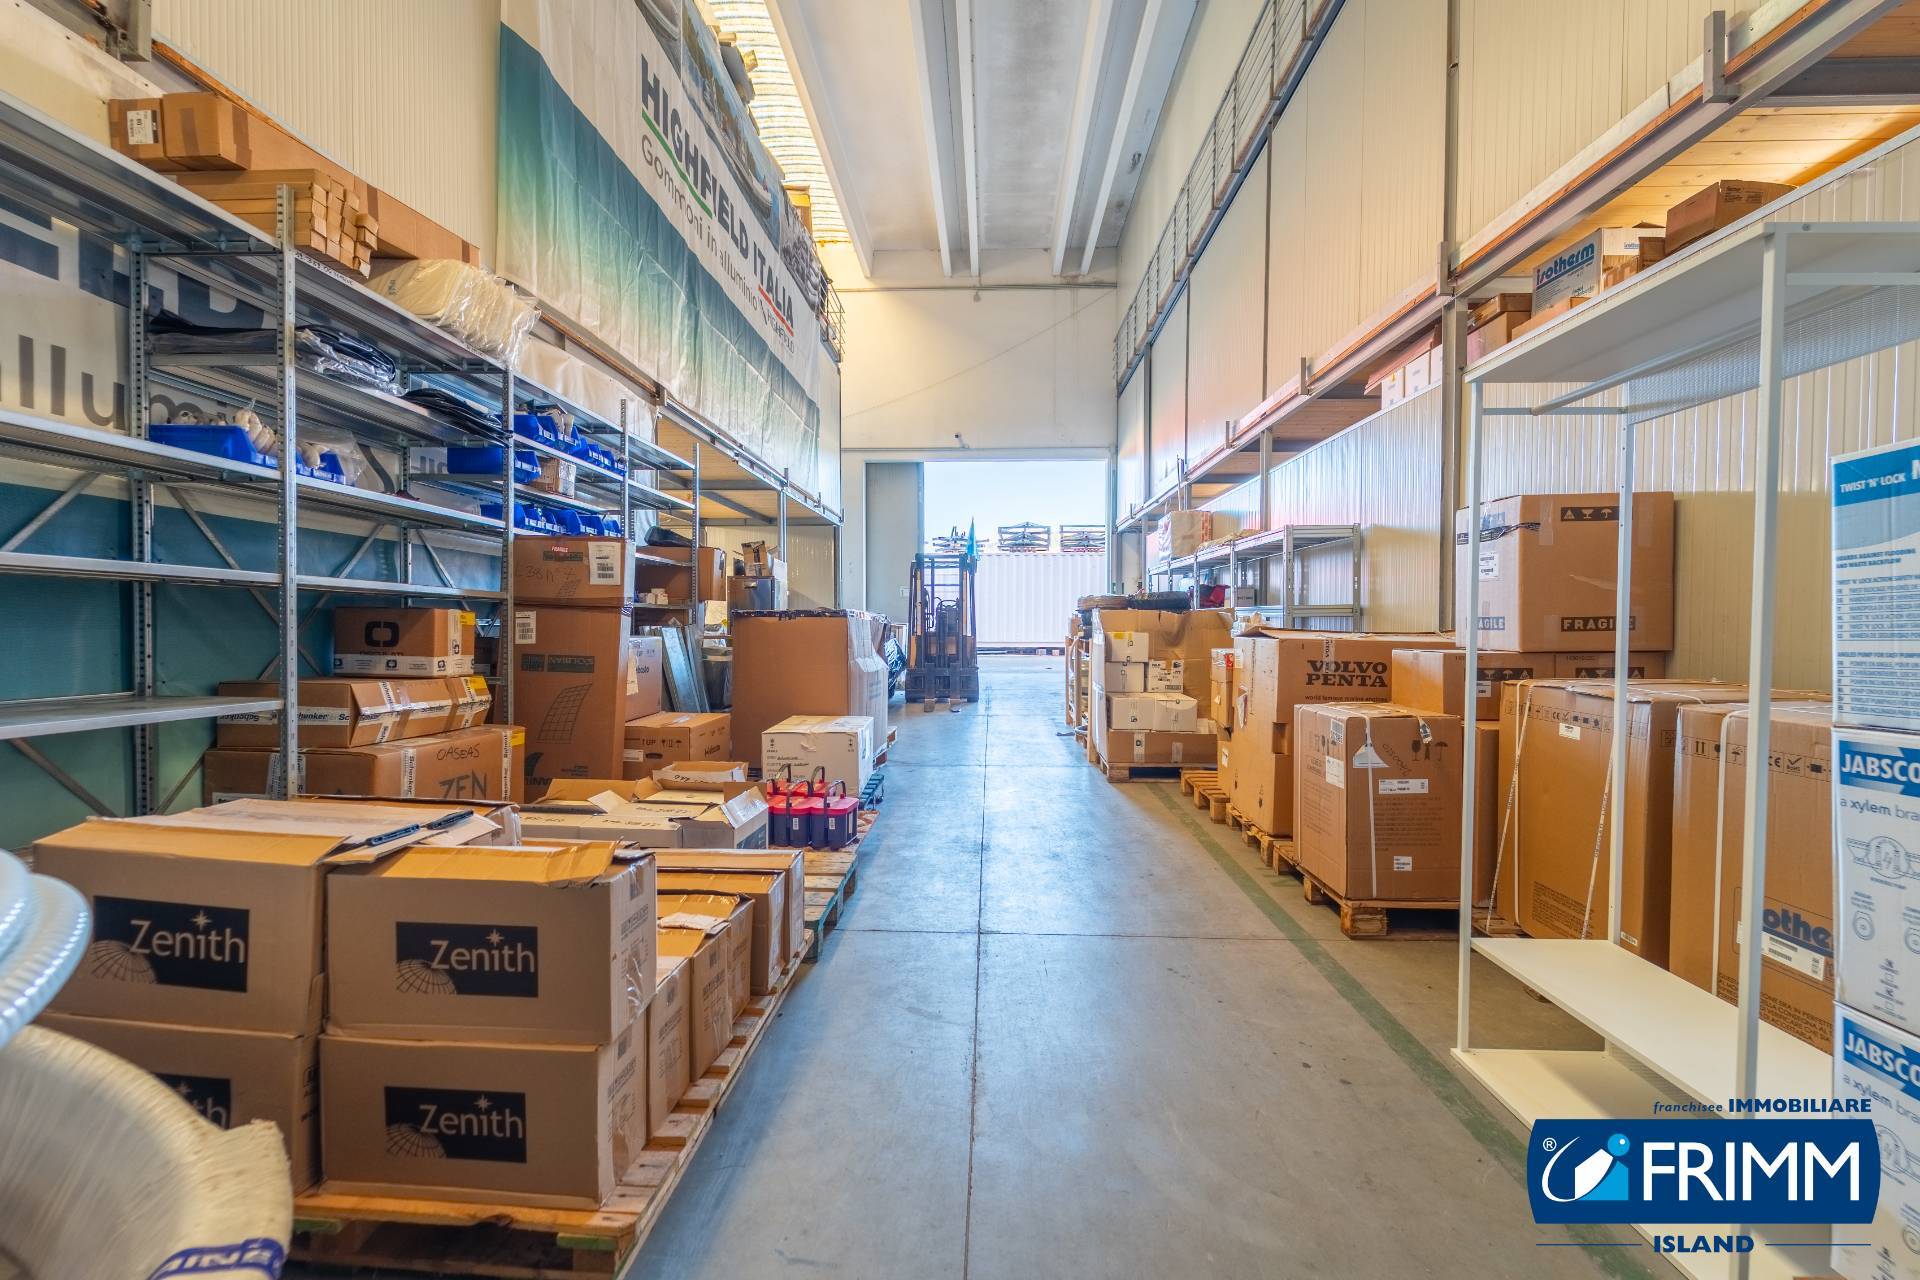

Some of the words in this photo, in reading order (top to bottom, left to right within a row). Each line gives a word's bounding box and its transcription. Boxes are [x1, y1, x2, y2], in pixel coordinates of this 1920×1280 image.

[641, 54, 749, 259] HIGHFIELD
[753, 240, 794, 329] ITALIA
[641, 134, 703, 240] Gommoni
[707, 227, 718, 257] in
[719, 249, 757, 311] alluminio
[1536, 242, 1595, 286] isotherm
[1840, 480, 1865, 493] TWIST
[1880, 472, 1906, 486] LOCK
[1477, 616, 1505, 631] AGILE
[1562, 618, 1634, 631] FRAGIE
[1306, 673, 1388, 688] PENTA
[1307, 659, 1388, 674] VOLVO
[1841, 753, 1920, 785] JABSCO
[1840, 798, 1847, 807] a
[1850, 799, 1892, 816] xylem
[1895, 804, 1920, 821] bra
[129, 918, 246, 964] Zenith
[1762, 907, 1833, 950] othe
[429, 939, 536, 973] Zenith
[1845, 1031, 1920, 1088] JABSCO
[418, 1103, 524, 1139] Zenith
[1895, 1100, 1920, 1125] bra
